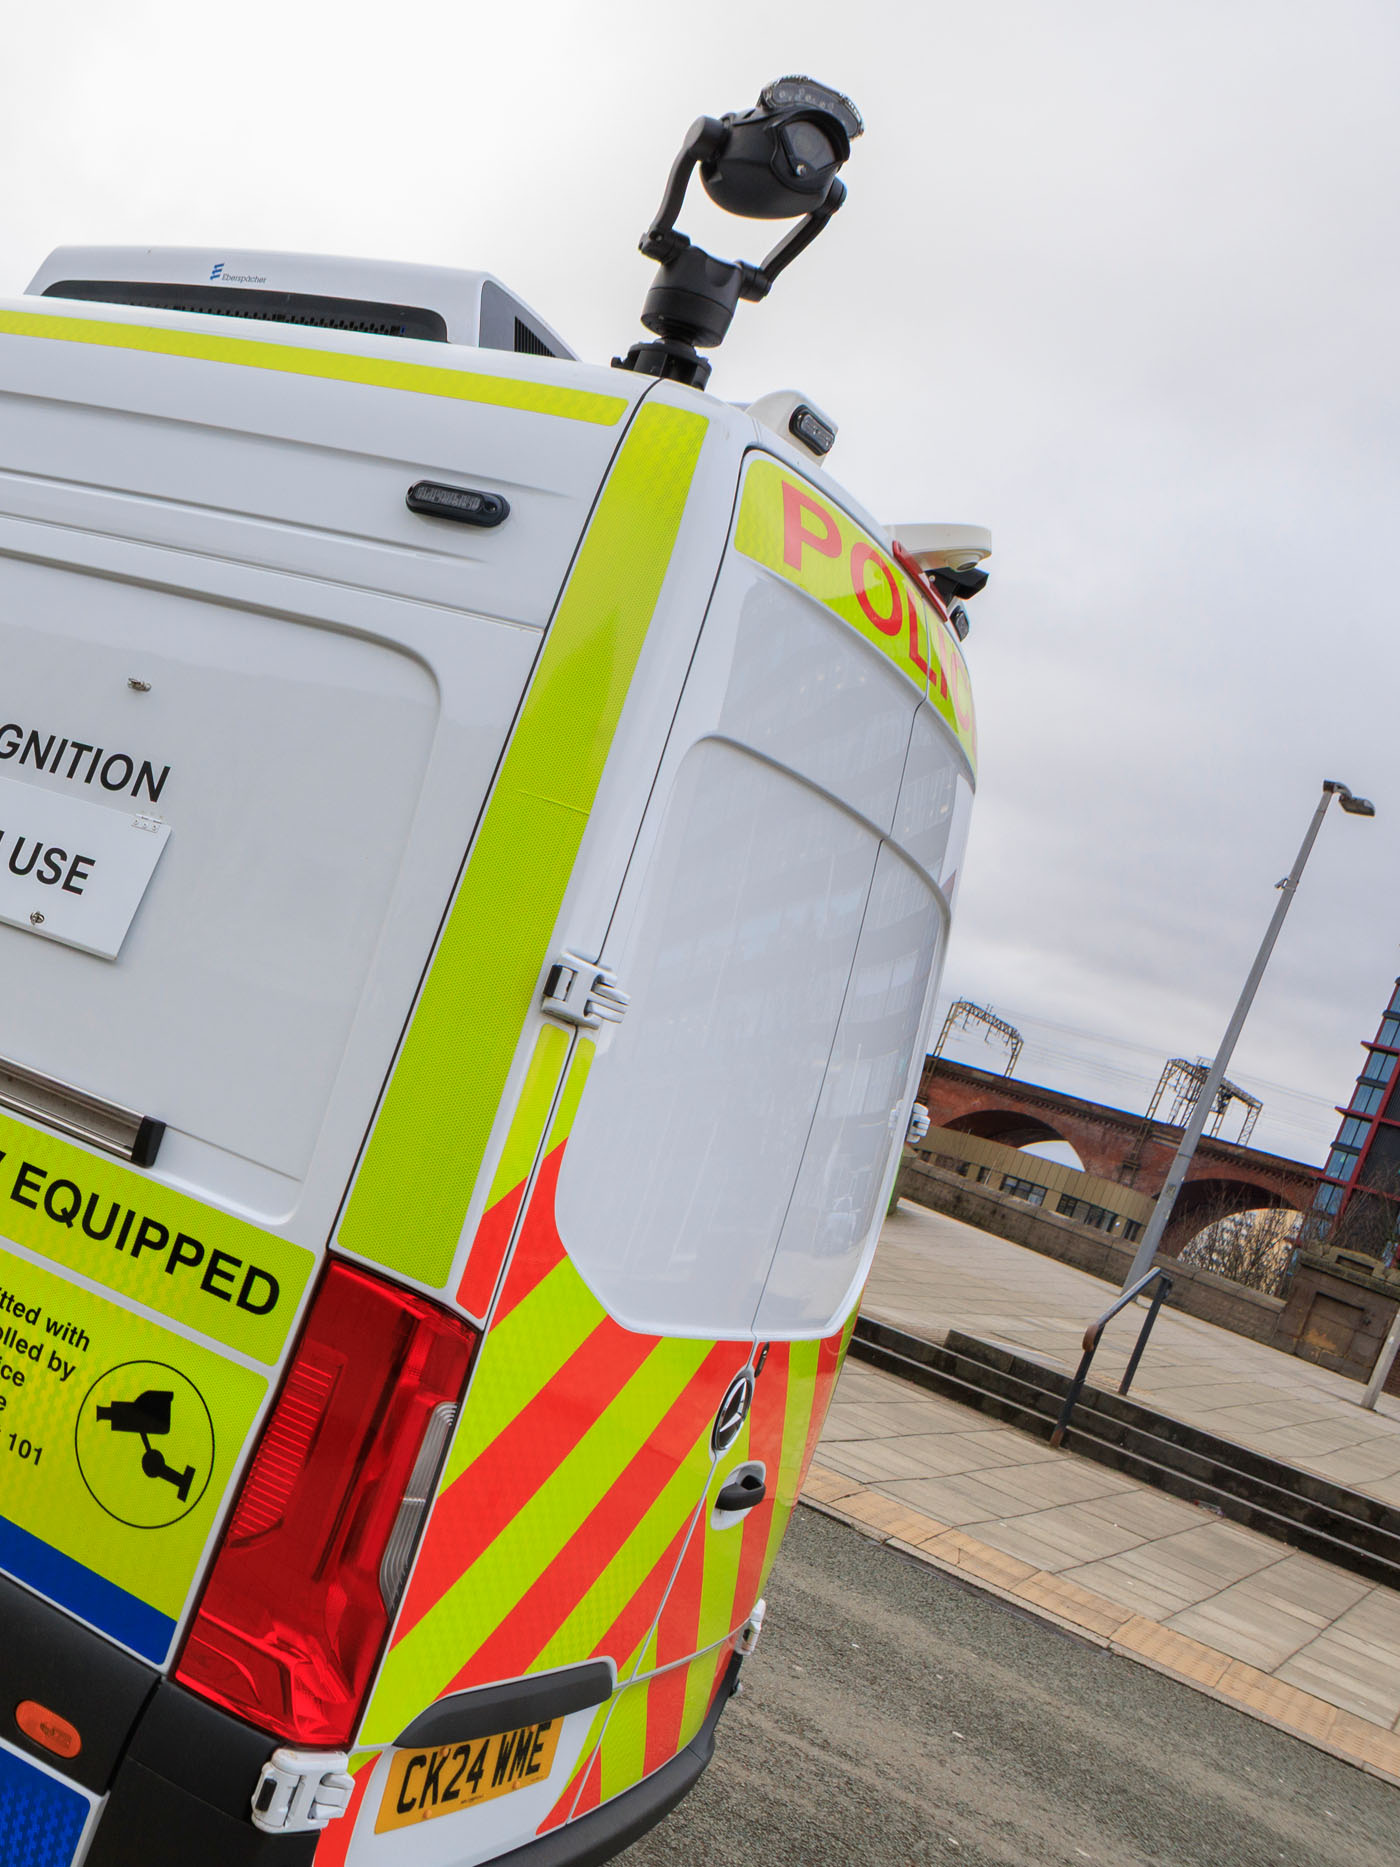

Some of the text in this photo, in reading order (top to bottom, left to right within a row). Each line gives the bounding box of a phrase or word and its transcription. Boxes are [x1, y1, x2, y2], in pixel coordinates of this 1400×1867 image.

[782, 479, 978, 762] POLIC
[8, 836, 96, 896] USE
[10, 1161, 281, 1316] EQUIPPED
[45, 1316, 90, 1352] with
[47, 1350, 77, 1382] by
[8, 1432, 43, 1466] 101
[396, 1722, 551, 1815] CK24 WME
